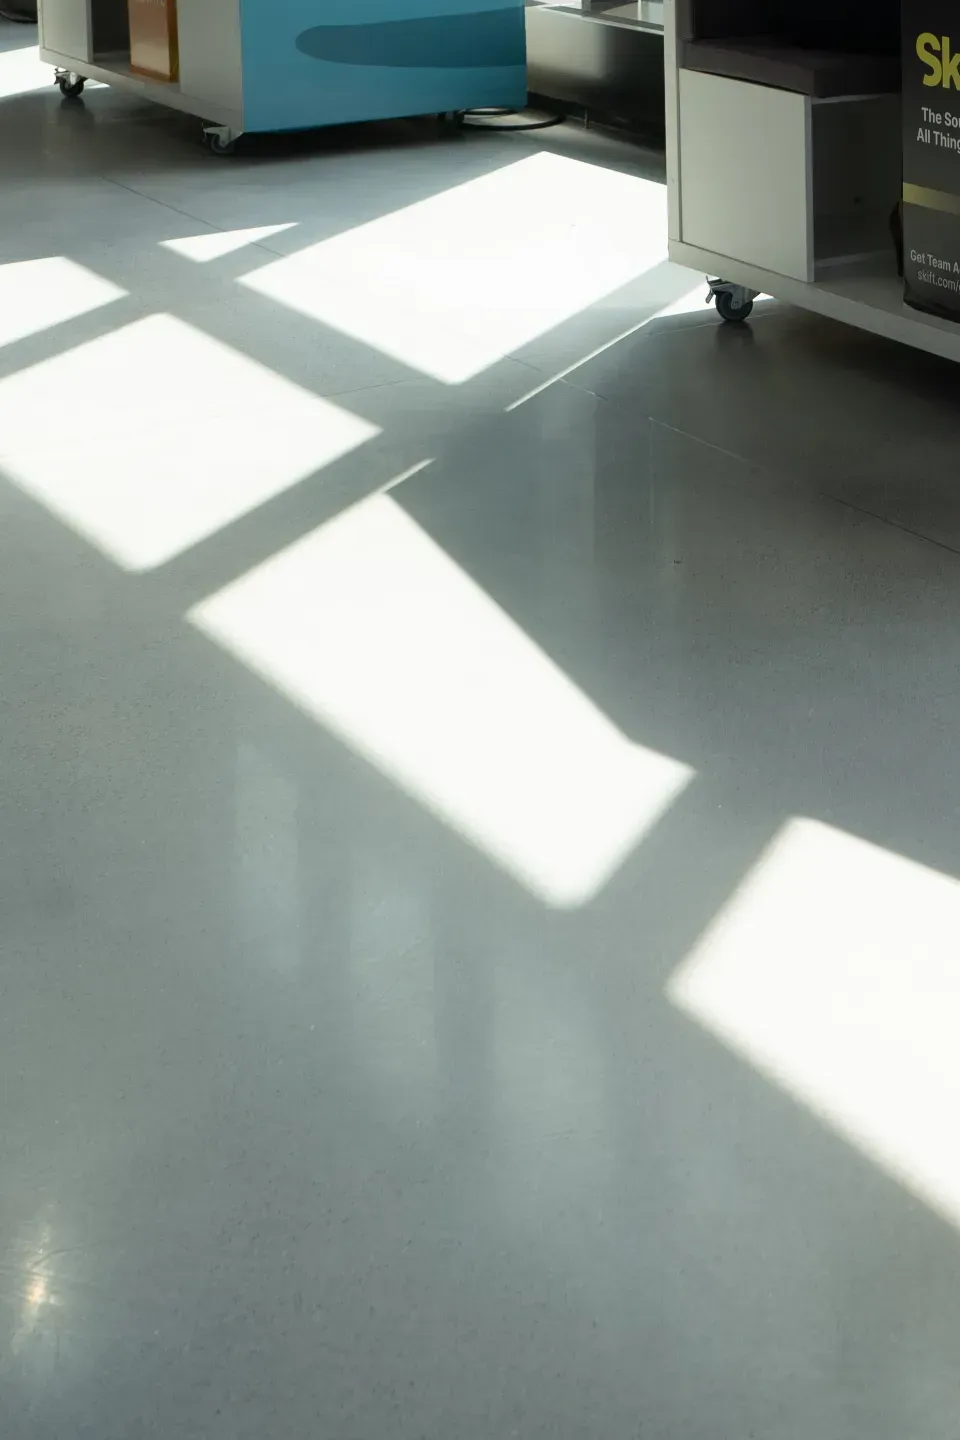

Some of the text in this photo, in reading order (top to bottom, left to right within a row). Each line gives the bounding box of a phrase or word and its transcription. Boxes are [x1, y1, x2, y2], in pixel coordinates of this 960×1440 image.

[921, 106, 942, 125] The
[916, 127, 931, 144] All
[910, 249, 926, 264] Get
[926, 253, 951, 272] Team
